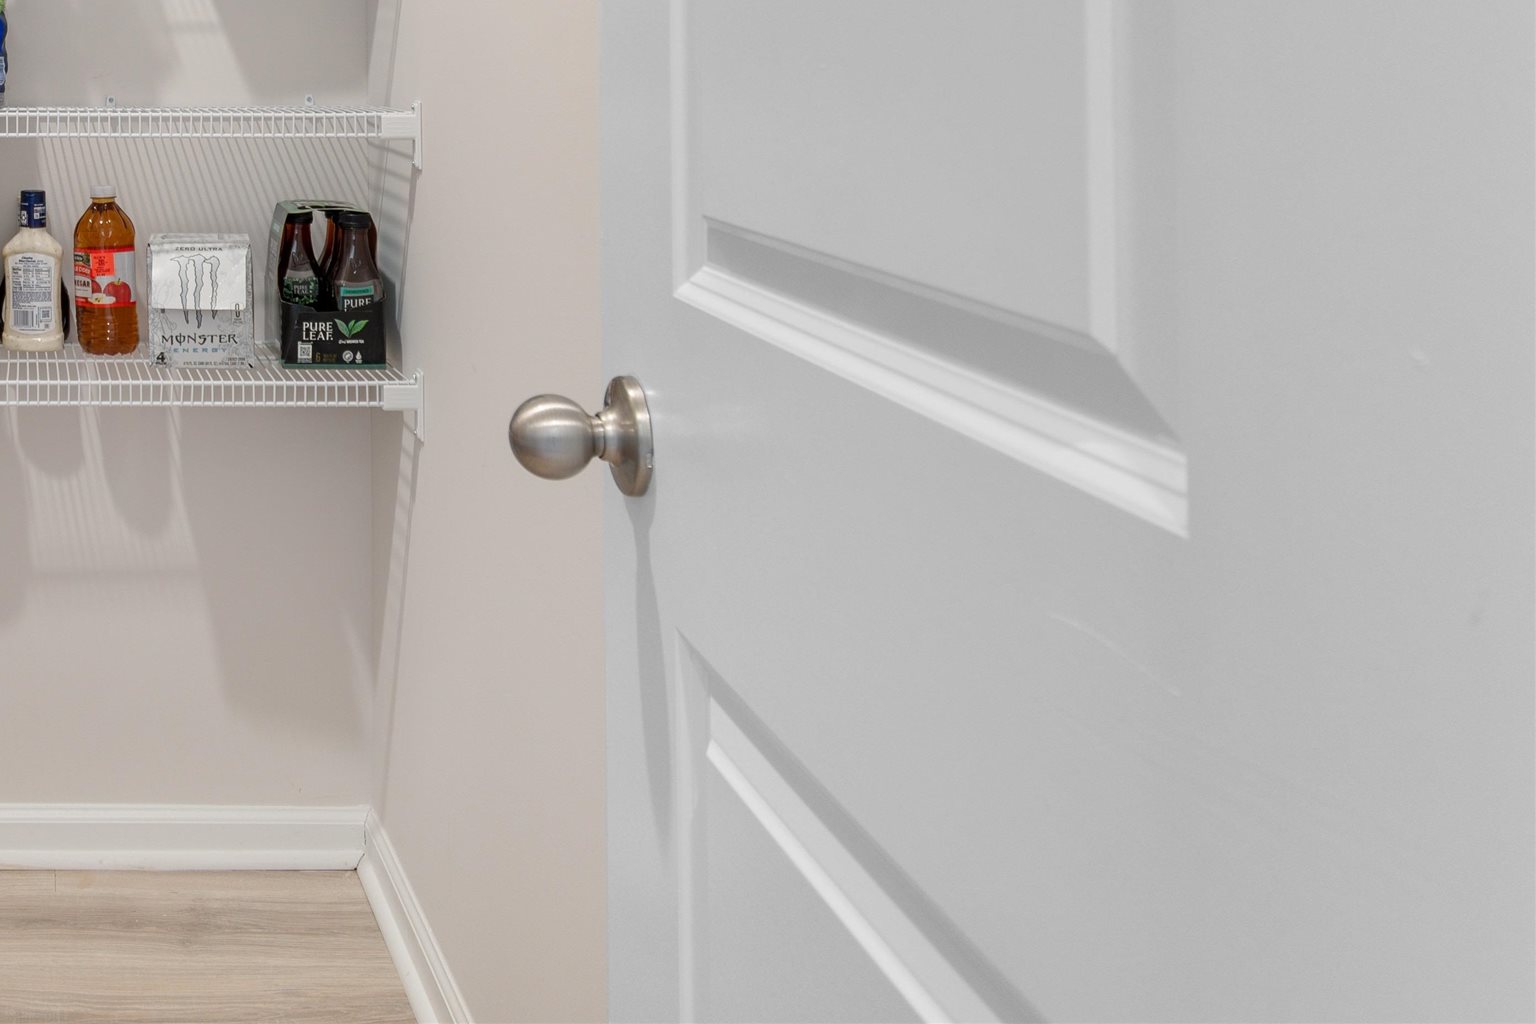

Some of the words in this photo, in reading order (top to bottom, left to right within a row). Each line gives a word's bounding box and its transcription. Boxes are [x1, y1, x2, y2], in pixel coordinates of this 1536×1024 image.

[302, 321, 333, 332] PURE
[161, 333, 238, 346] MONSTER
[156, 352, 166, 362] 4
